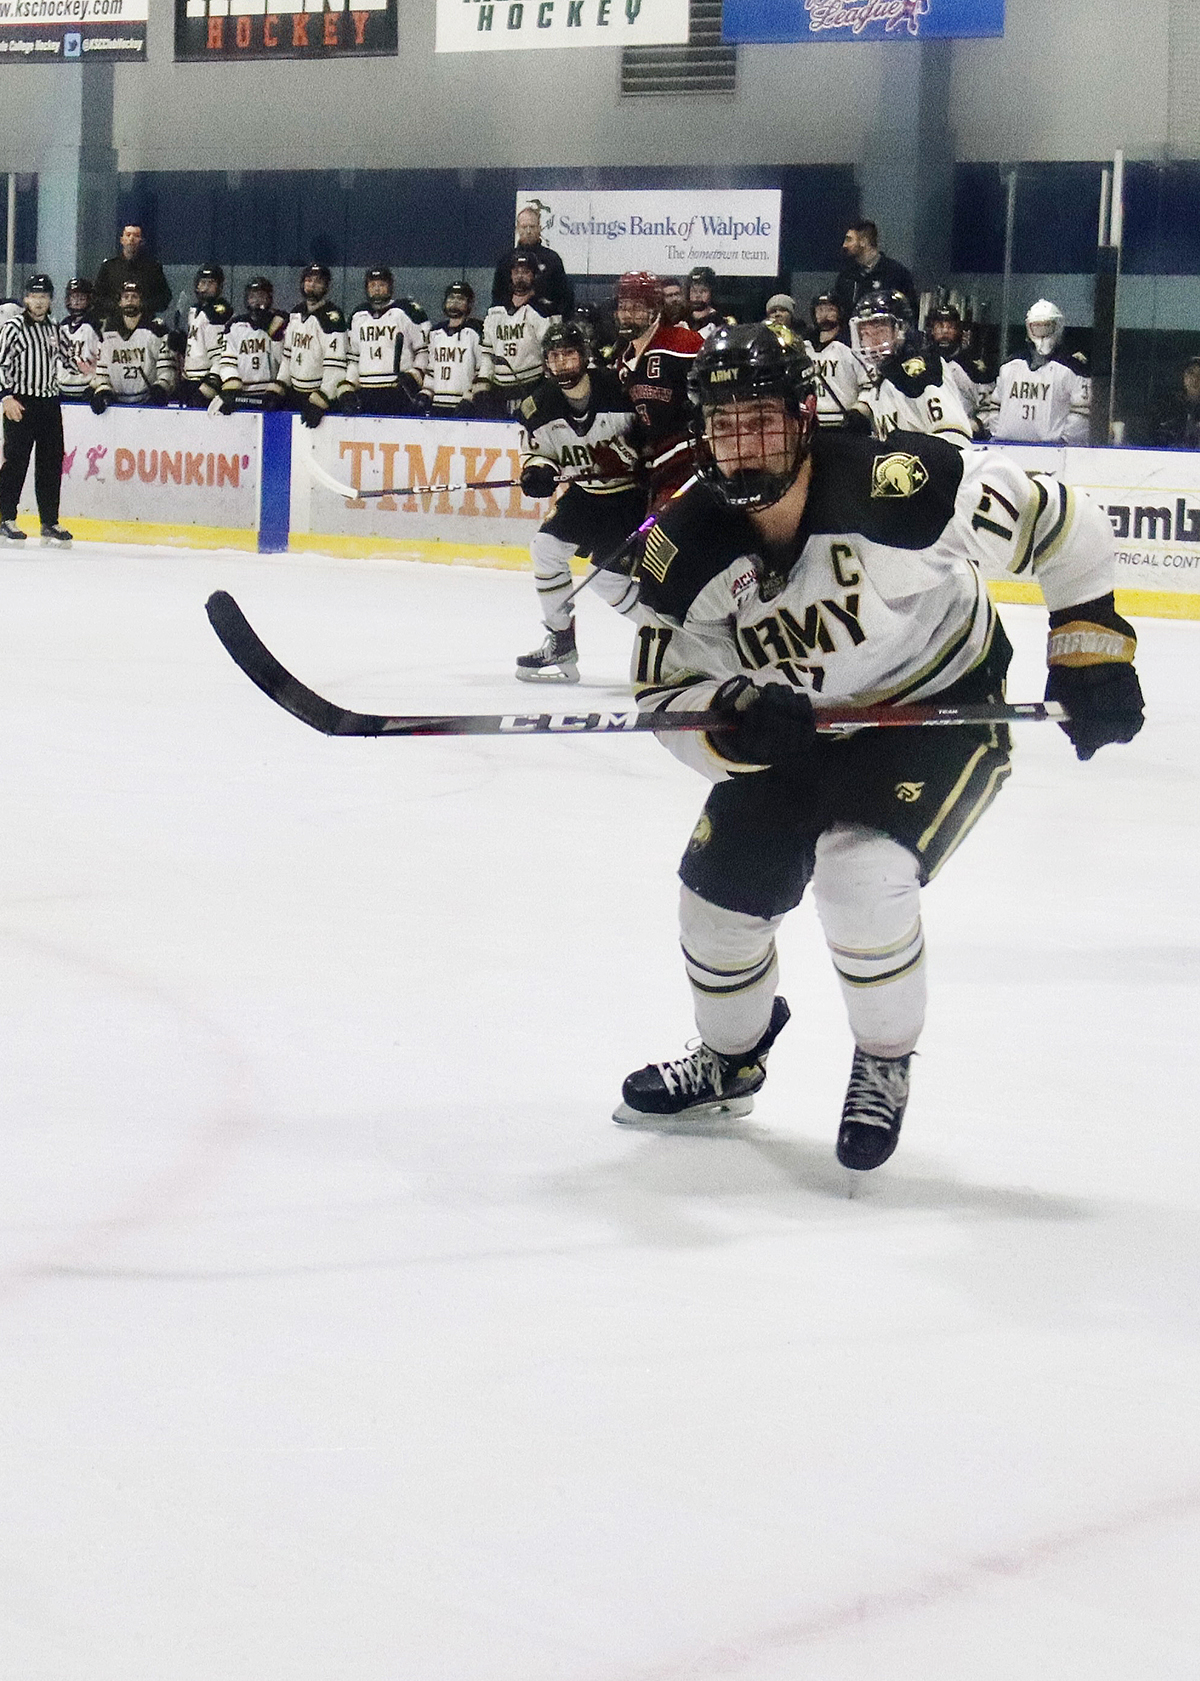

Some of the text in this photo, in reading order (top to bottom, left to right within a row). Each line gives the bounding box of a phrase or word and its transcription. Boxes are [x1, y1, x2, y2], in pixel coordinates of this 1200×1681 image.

[476, 0, 642, 32] HOCKEY
[205, 10, 371, 50] HOCKEY
[558, 215, 771, 241] Savings Bank of Walpole
[666, 245, 770, 260] The hometown team.
[359, 325, 397, 342] ARMY
[496, 323, 526, 341] ARMY
[240, 338, 267, 355] ARM
[329, 338, 337, 352] 4
[369, 346, 382, 360] 14
[112, 347, 146, 364] ARMY
[433, 347, 467, 363] ARMY
[123, 367, 138, 380] 23
[710, 367, 740, 384] ARMY
[1009, 381, 1051, 401] ARMY
[927, 396, 944, 423] 6
[1022, 404, 1036, 421] 31
[115, 447, 250, 488] DUNKIN'
[339, 440, 552, 521] TIMK
[970, 482, 1021, 541] 17
[1098, 497, 1200, 542] amb
[830, 543, 860, 588] C
[499, 712, 640, 732] CCM
